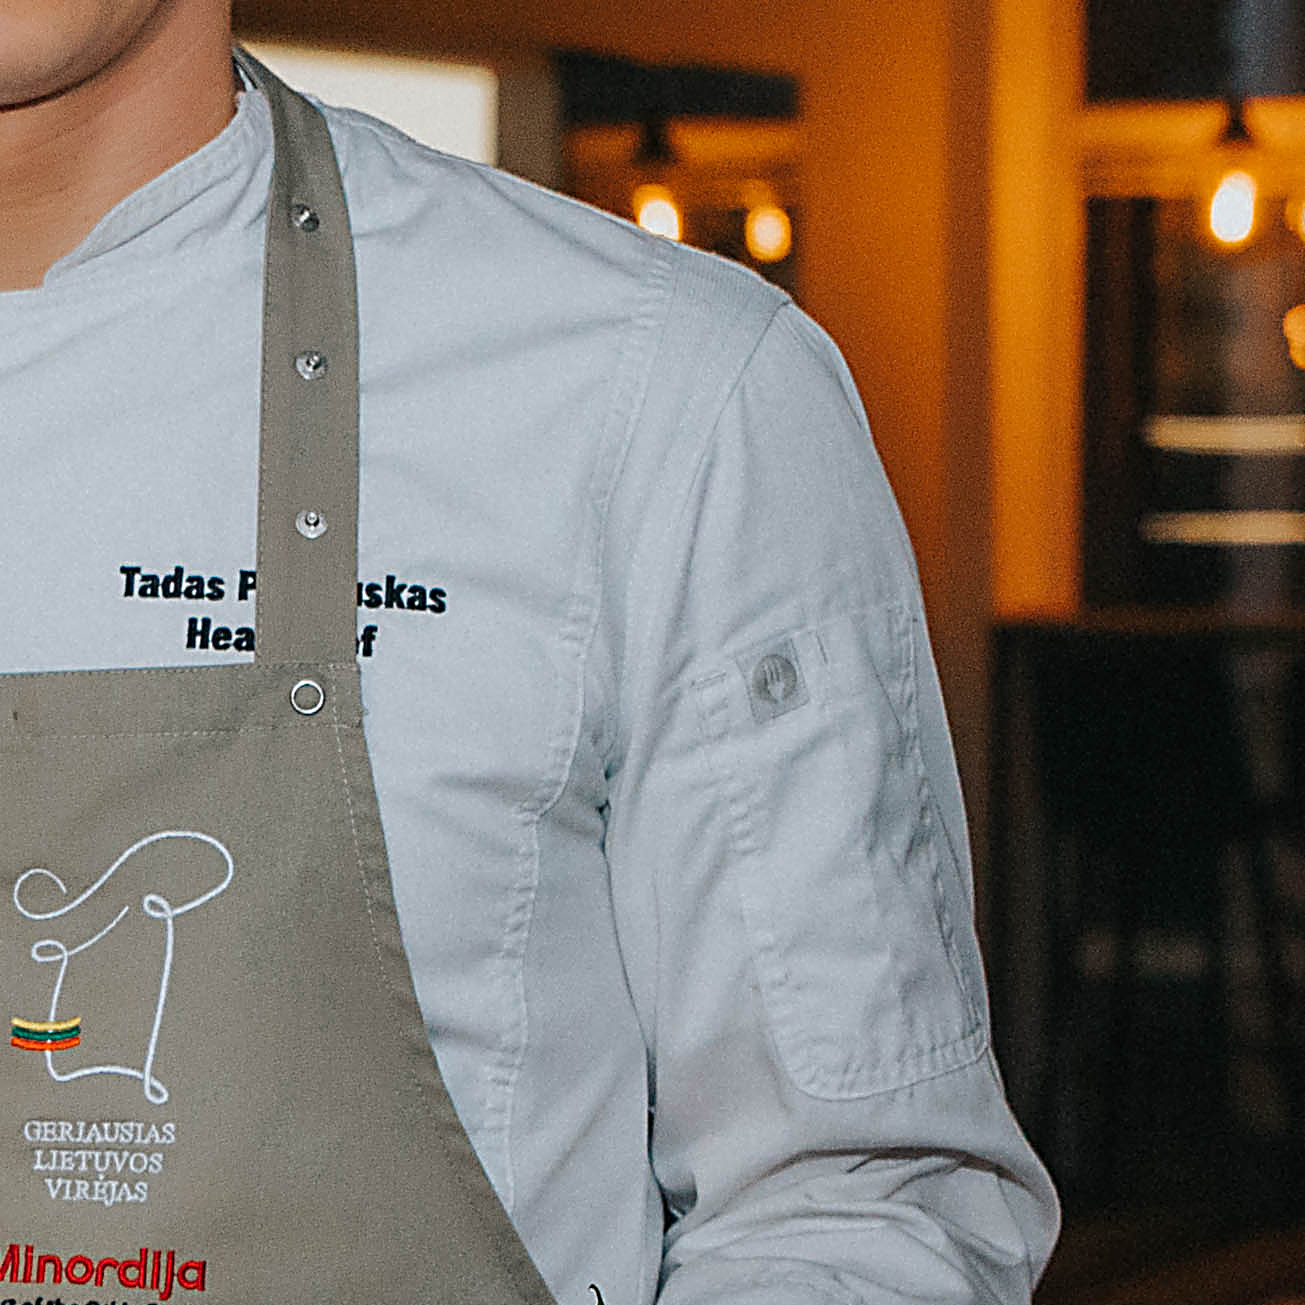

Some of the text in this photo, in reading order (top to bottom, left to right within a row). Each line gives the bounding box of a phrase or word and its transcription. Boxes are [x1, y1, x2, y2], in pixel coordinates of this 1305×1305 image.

[120, 566, 225, 600] Tadas
[186, 617, 256, 652] Hea
[24, 1121, 176, 1145] GERIAUSIAS
[33, 1150, 164, 1174] LIETUVOS
